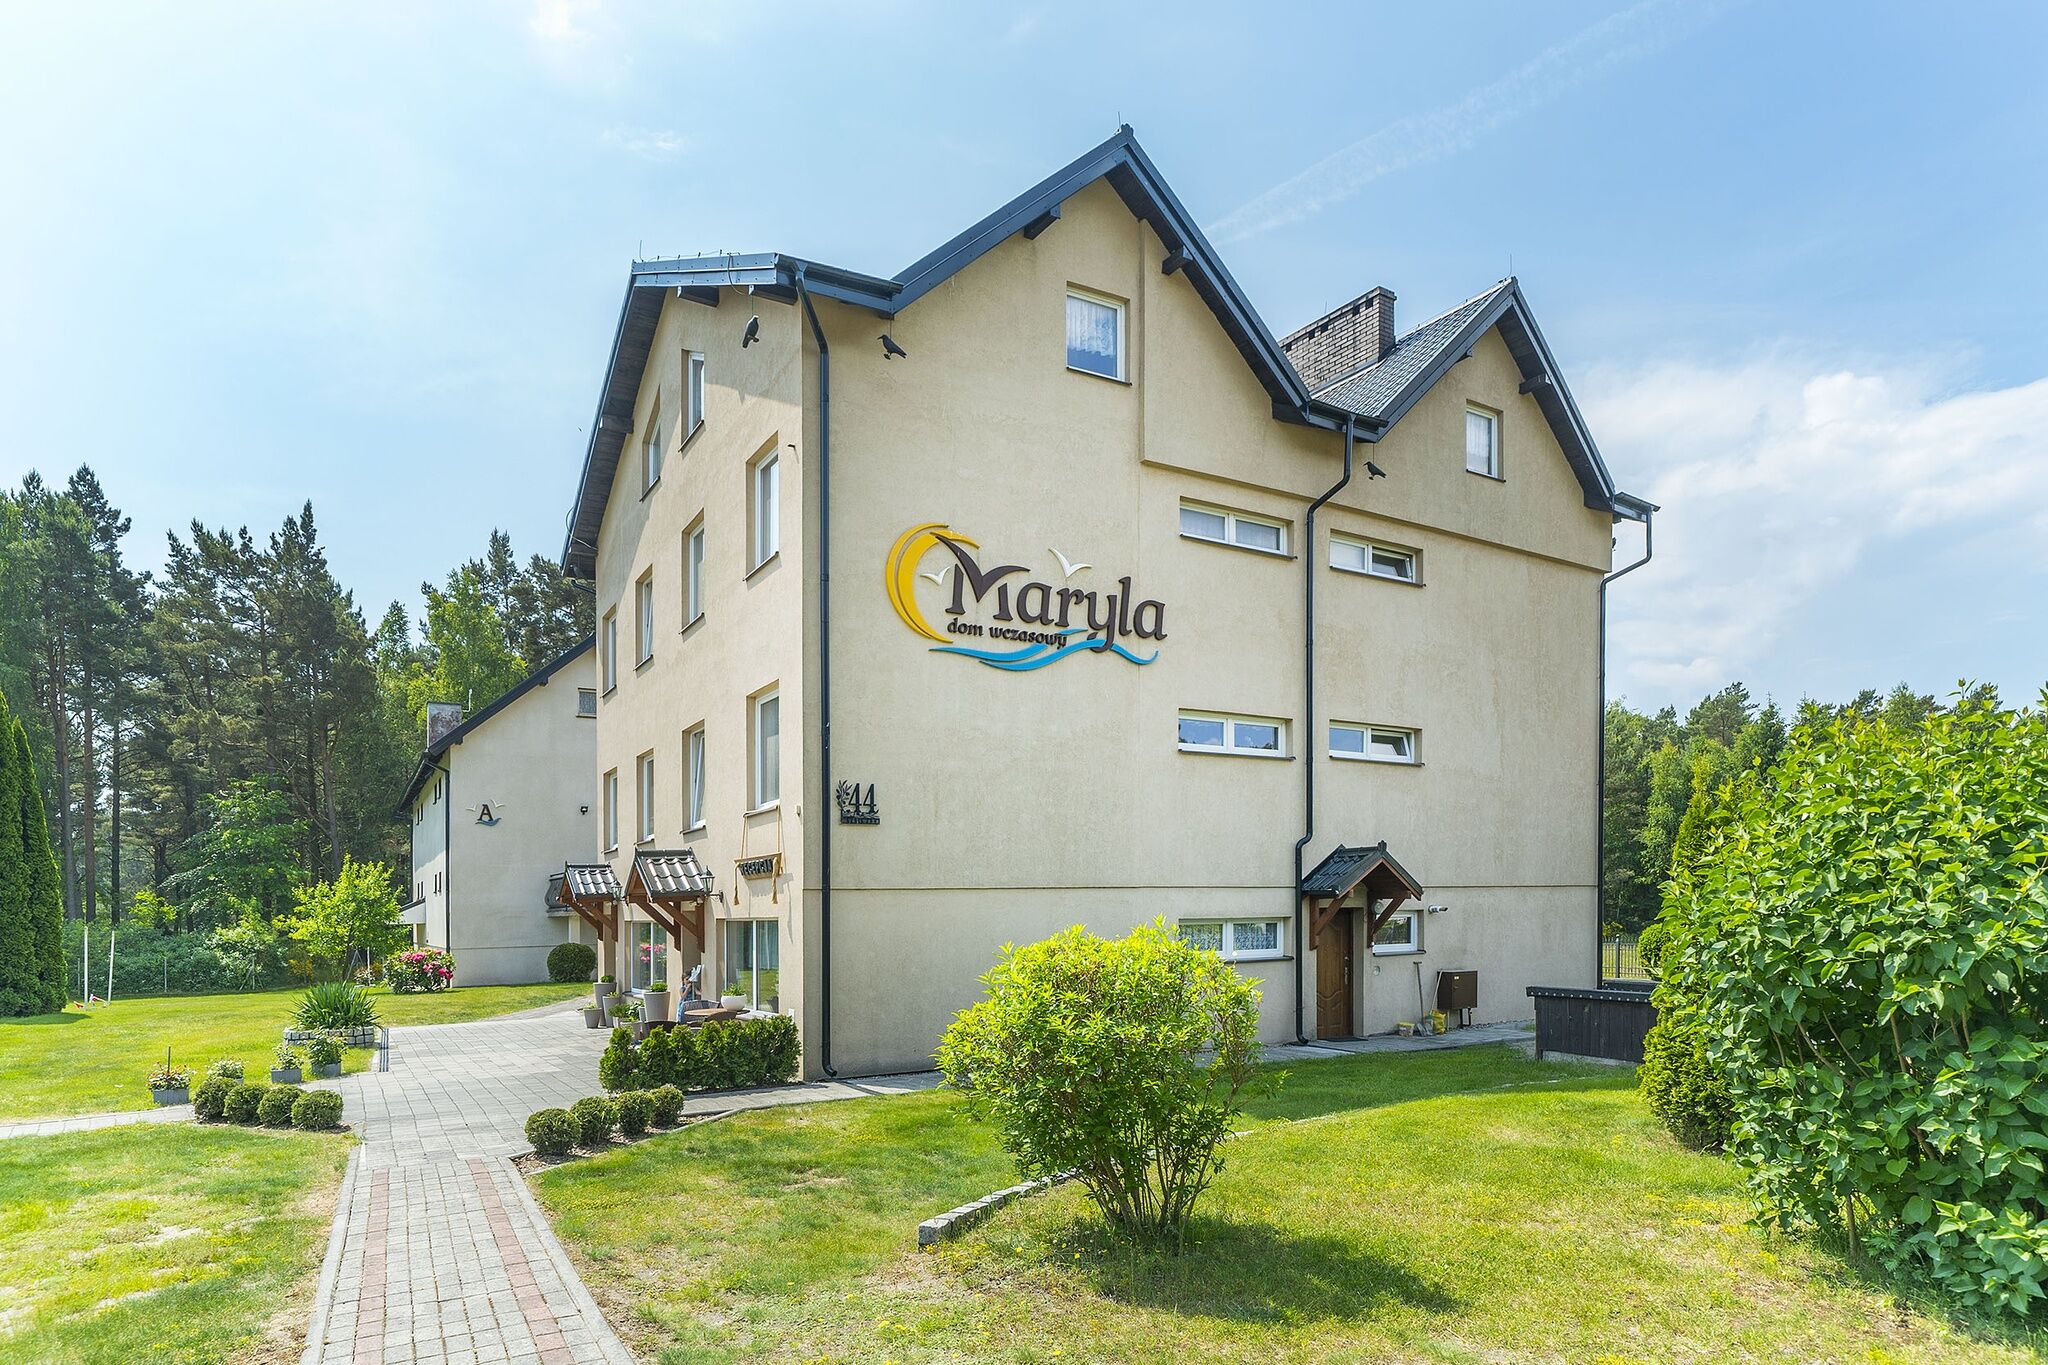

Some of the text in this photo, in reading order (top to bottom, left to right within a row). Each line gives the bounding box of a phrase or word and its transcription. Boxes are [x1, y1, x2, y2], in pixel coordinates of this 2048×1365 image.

[935, 536, 1168, 653] Maryla
[946, 617, 1067, 649] dom wczasowy
[477, 804, 494, 821] A
[848, 783, 877, 814] 44
